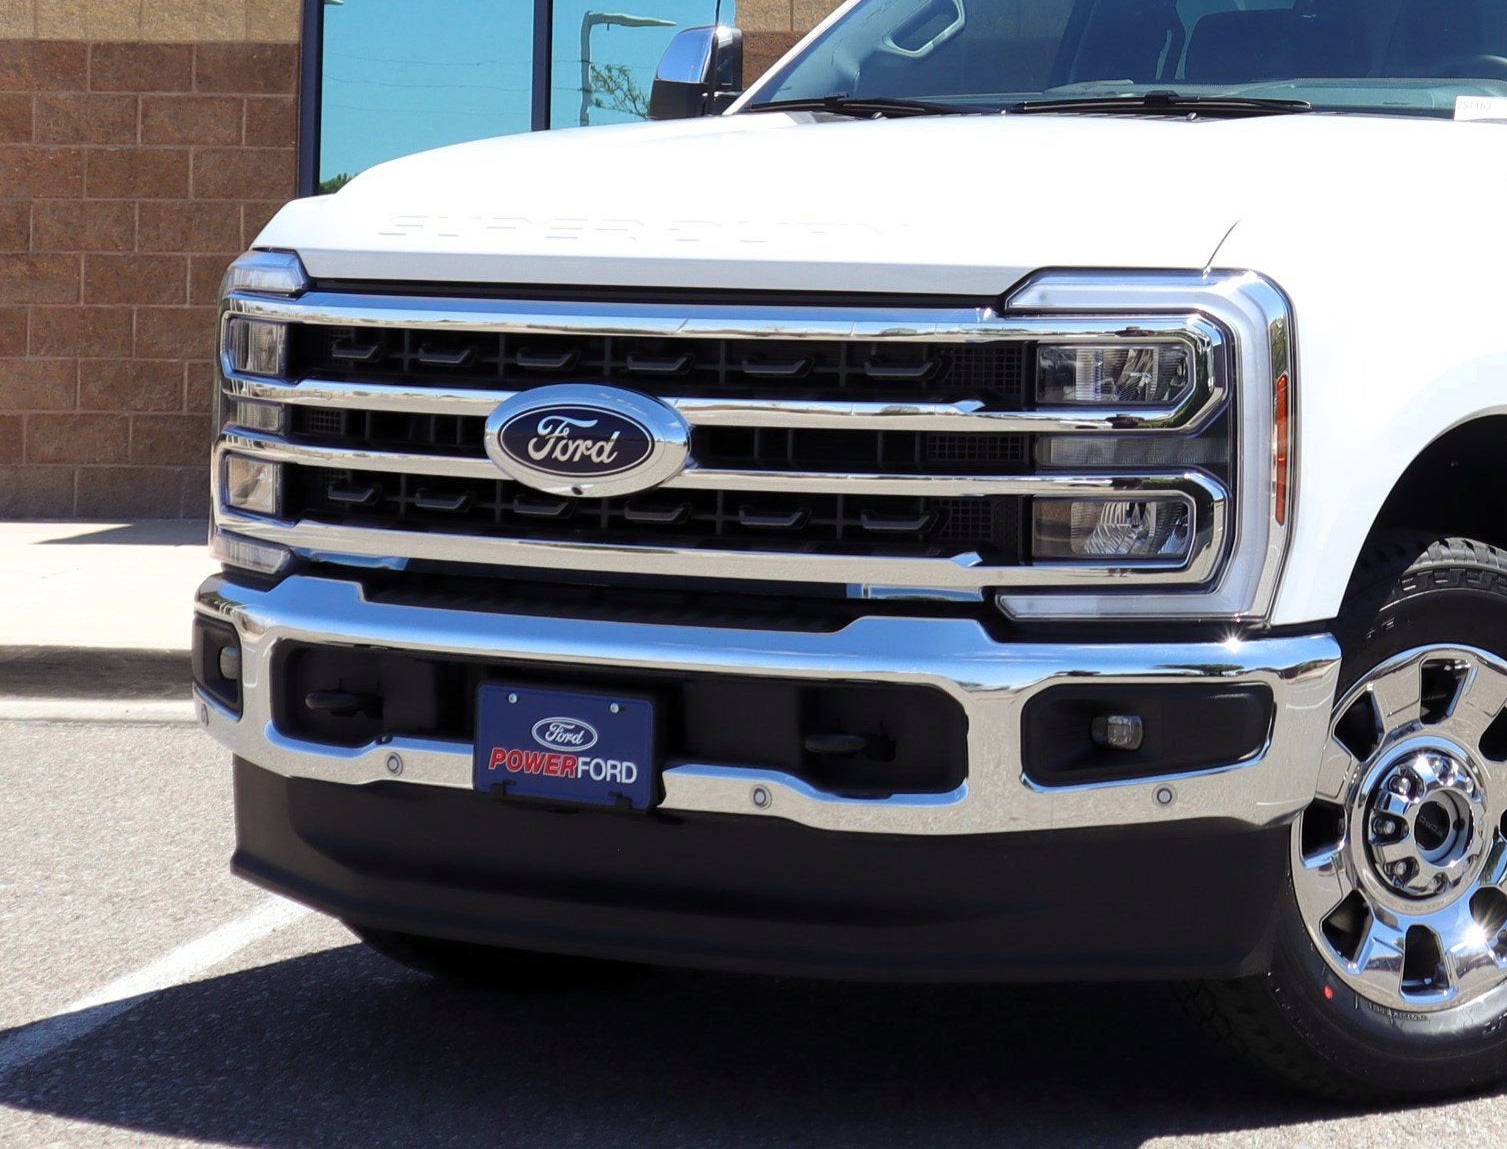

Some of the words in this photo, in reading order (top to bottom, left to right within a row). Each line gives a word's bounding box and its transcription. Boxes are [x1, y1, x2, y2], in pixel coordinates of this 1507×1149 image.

[528, 415, 620, 464] Ford
[545, 722, 586, 745] Ford
[488, 747, 638, 784] POWERFORD
